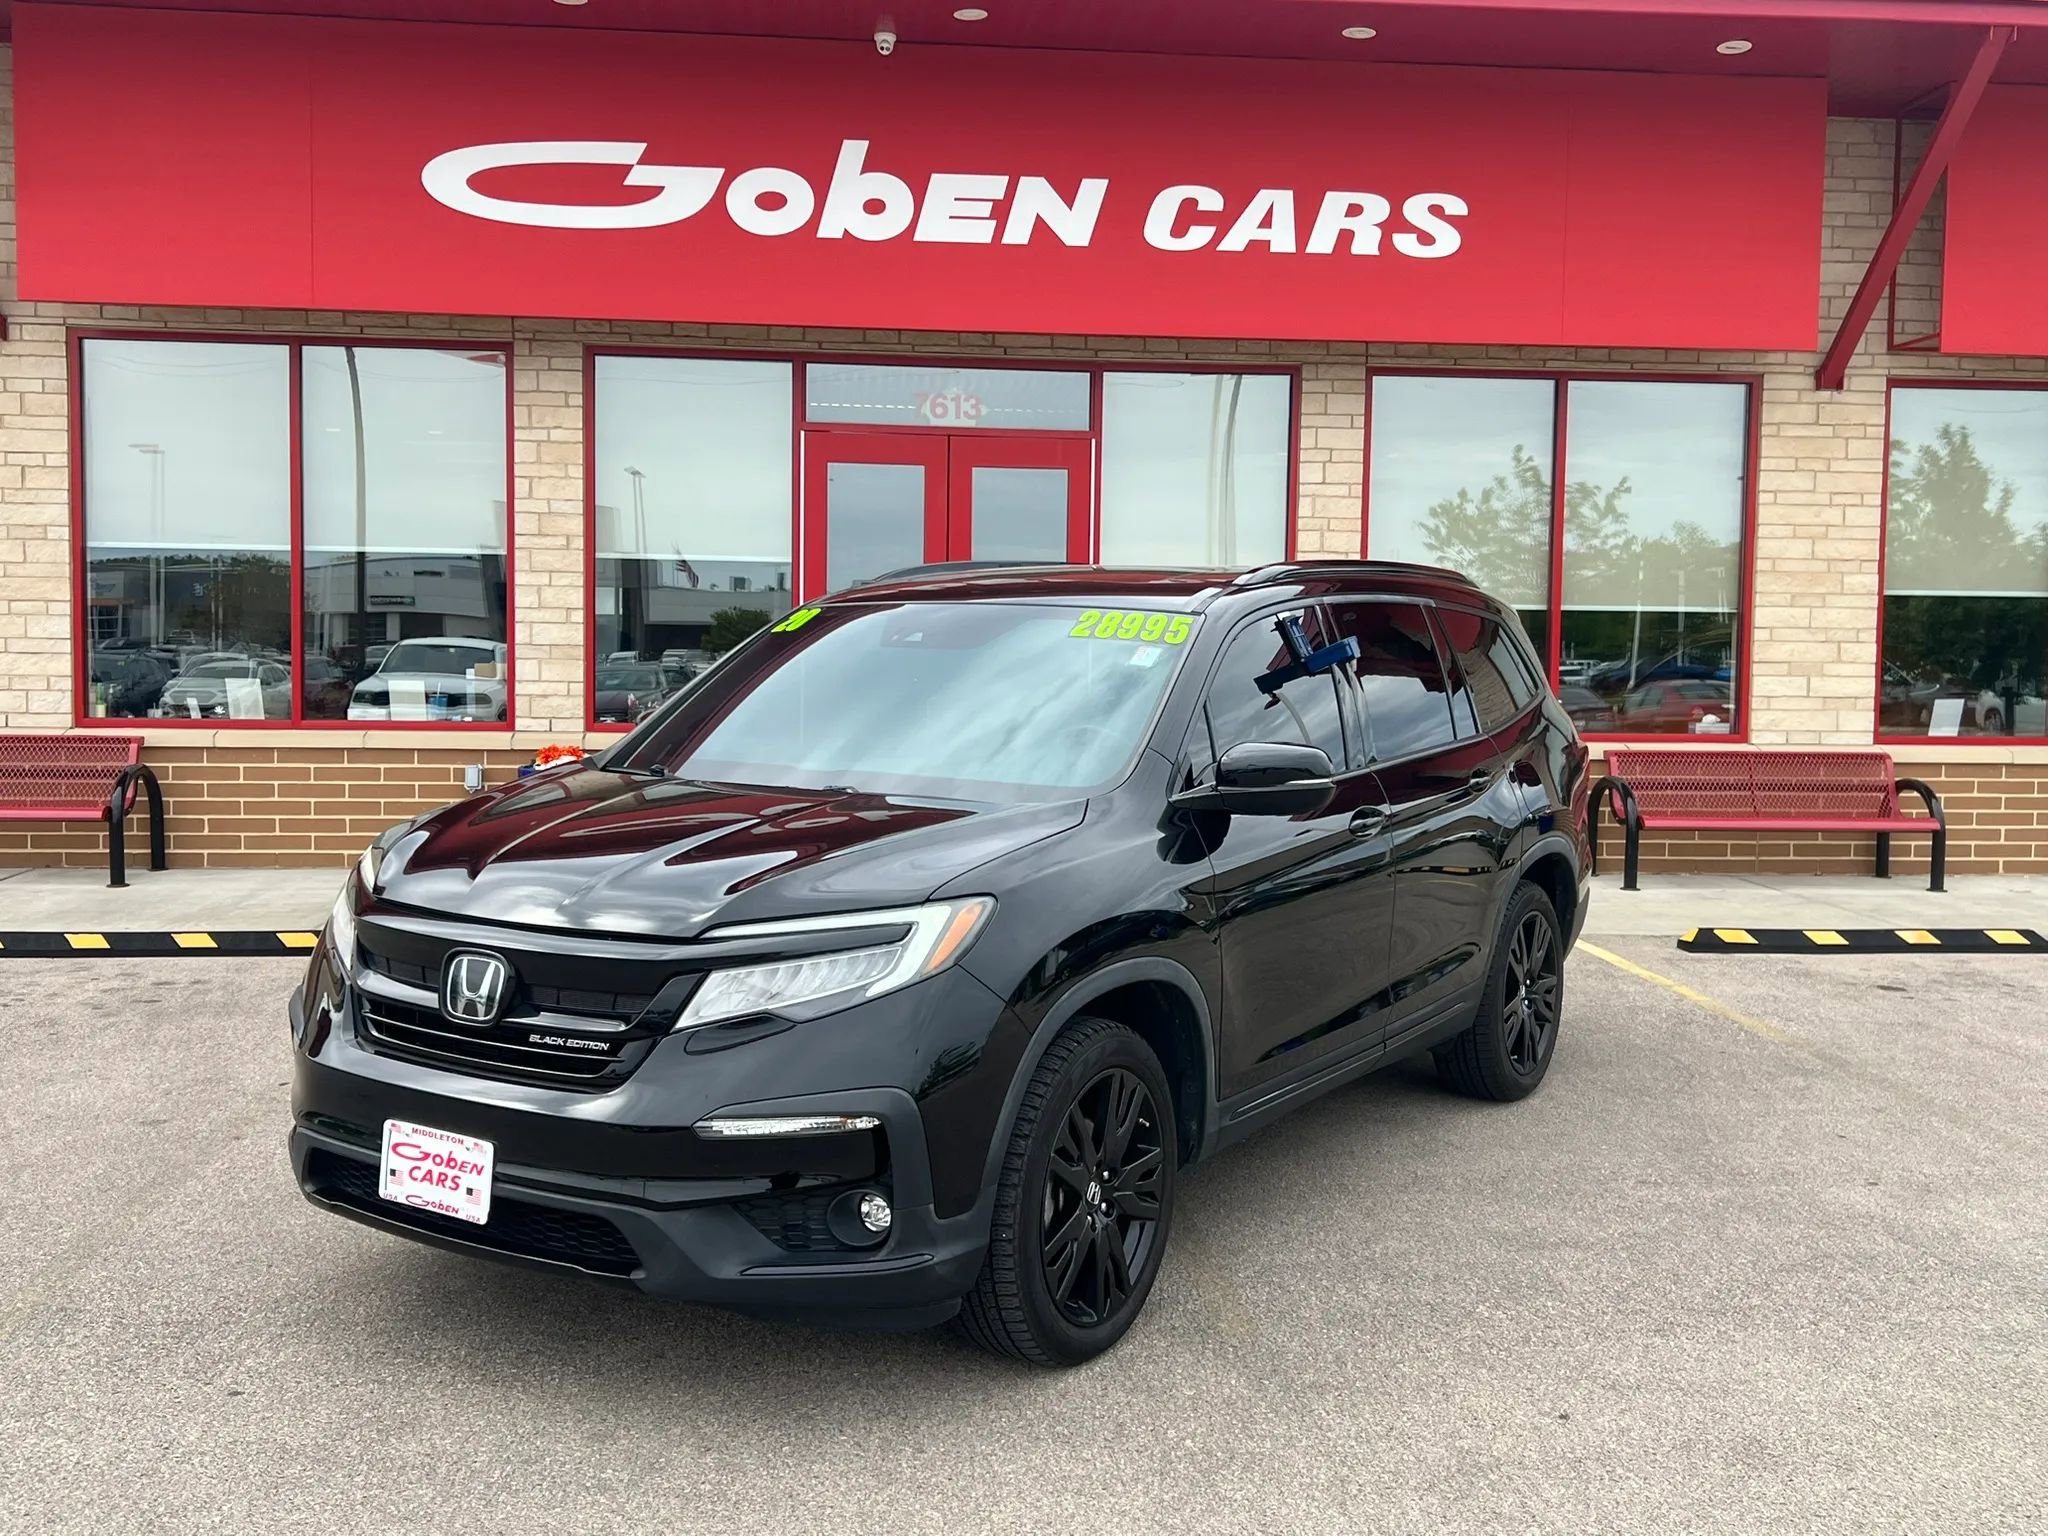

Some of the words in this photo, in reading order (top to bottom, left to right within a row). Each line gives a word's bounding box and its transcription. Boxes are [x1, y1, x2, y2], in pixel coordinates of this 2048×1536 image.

[1143, 184, 1469, 260] CARS
[913, 391, 984, 420] 7613
[1069, 609, 1194, 645] 28995
[529, 1034, 565, 1046] BLACK
[566, 1039, 610, 1051] EDITION
[411, 1127, 465, 1145] MIDDLETON
[408, 1165, 462, 1191] CARS
[382, 1192, 398, 1201] USA
[465, 1213, 481, 1223] USA
